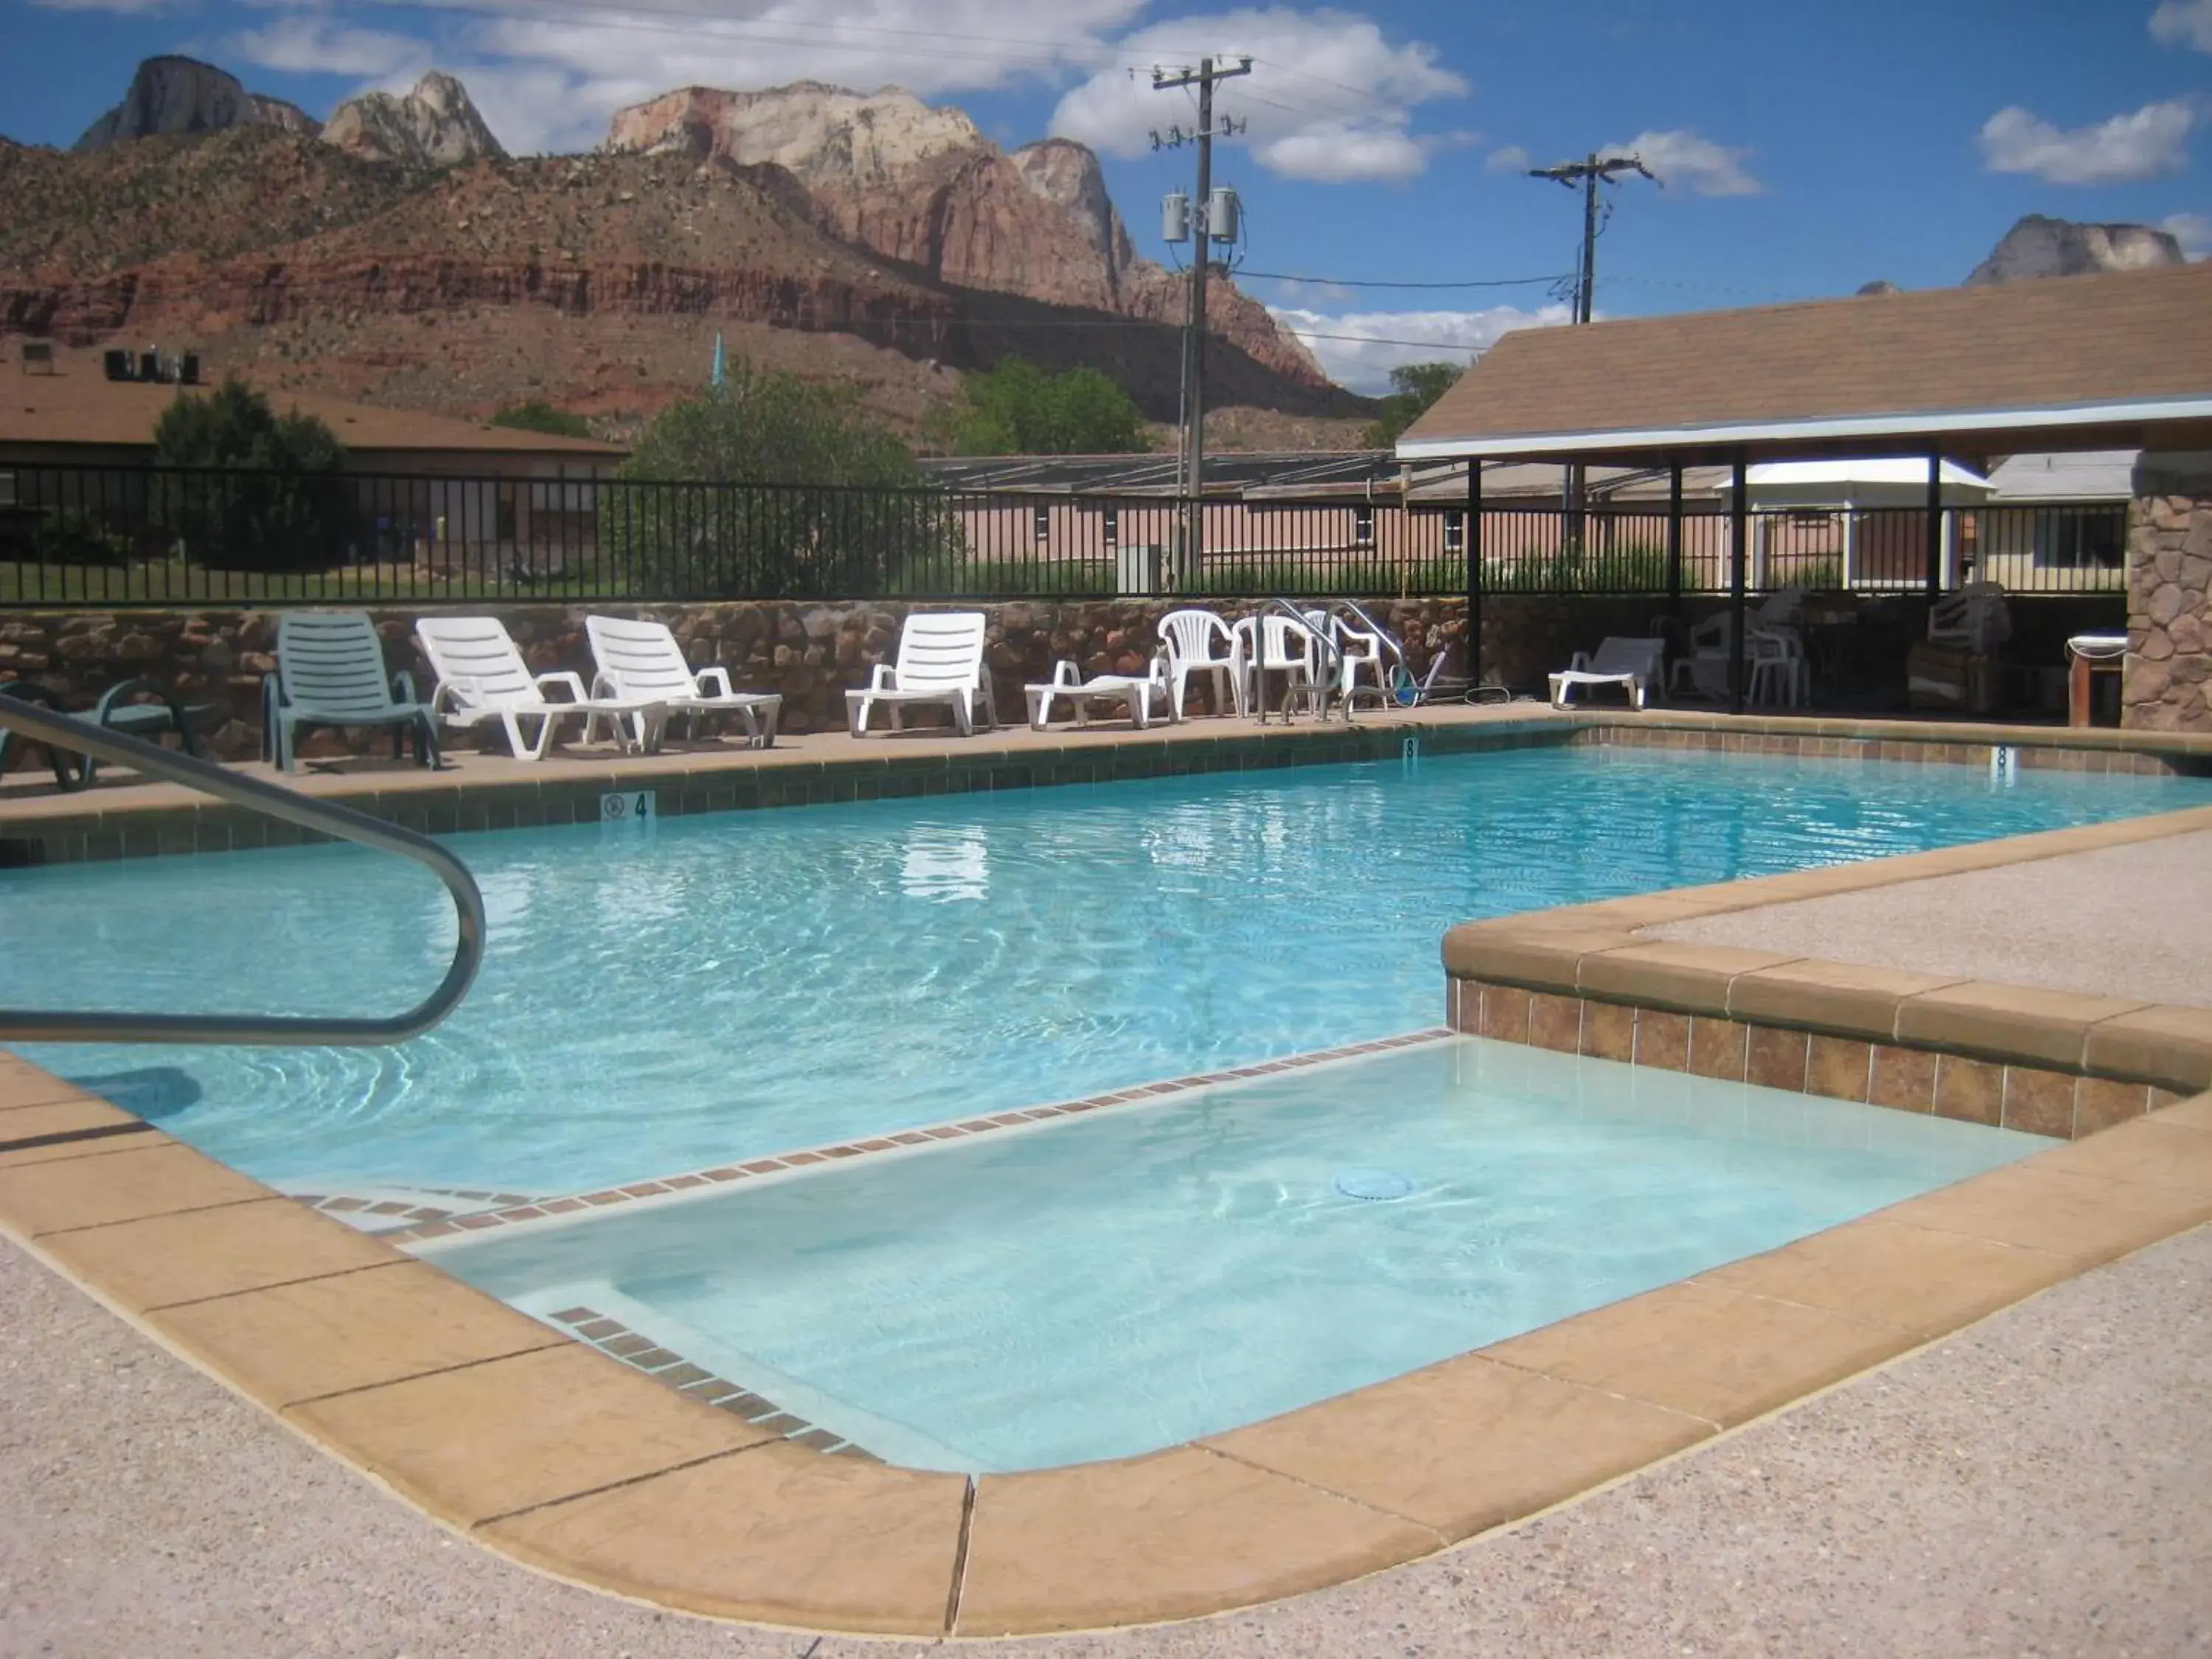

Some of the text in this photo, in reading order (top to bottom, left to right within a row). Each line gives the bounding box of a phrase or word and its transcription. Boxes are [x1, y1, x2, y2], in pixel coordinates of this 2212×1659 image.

[1407, 740, 1413, 757] 8
[1997, 746, 2006, 767] 8
[635, 793, 647, 816] 4
